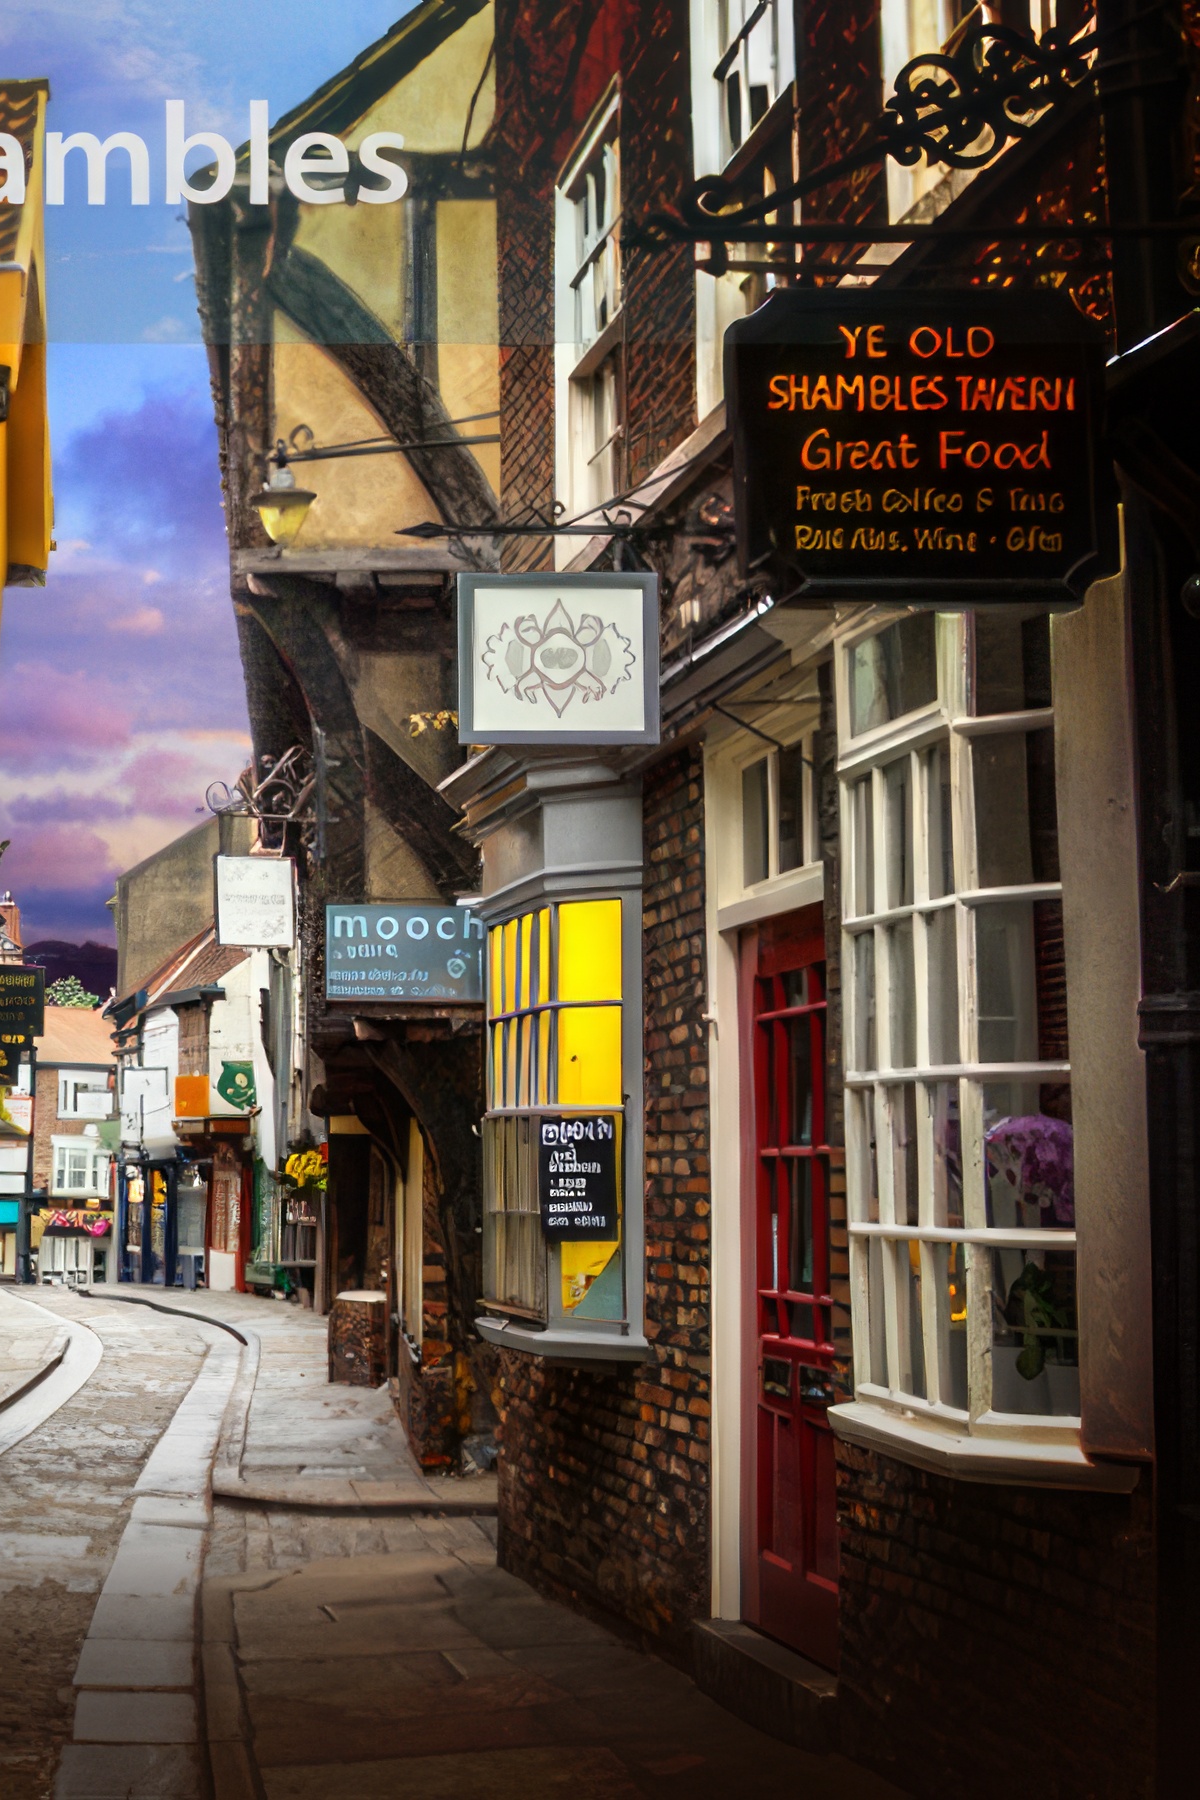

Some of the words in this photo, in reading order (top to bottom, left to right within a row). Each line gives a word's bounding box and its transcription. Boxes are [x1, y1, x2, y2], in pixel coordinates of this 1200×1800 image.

[838, 324, 888, 359] YE
[908, 325, 995, 359] OLD
[767, 374, 949, 412] SHAMBLES
[801, 428, 920, 471] Great
[939, 430, 1052, 471] Food
[333, 908, 484, 941] mooch
